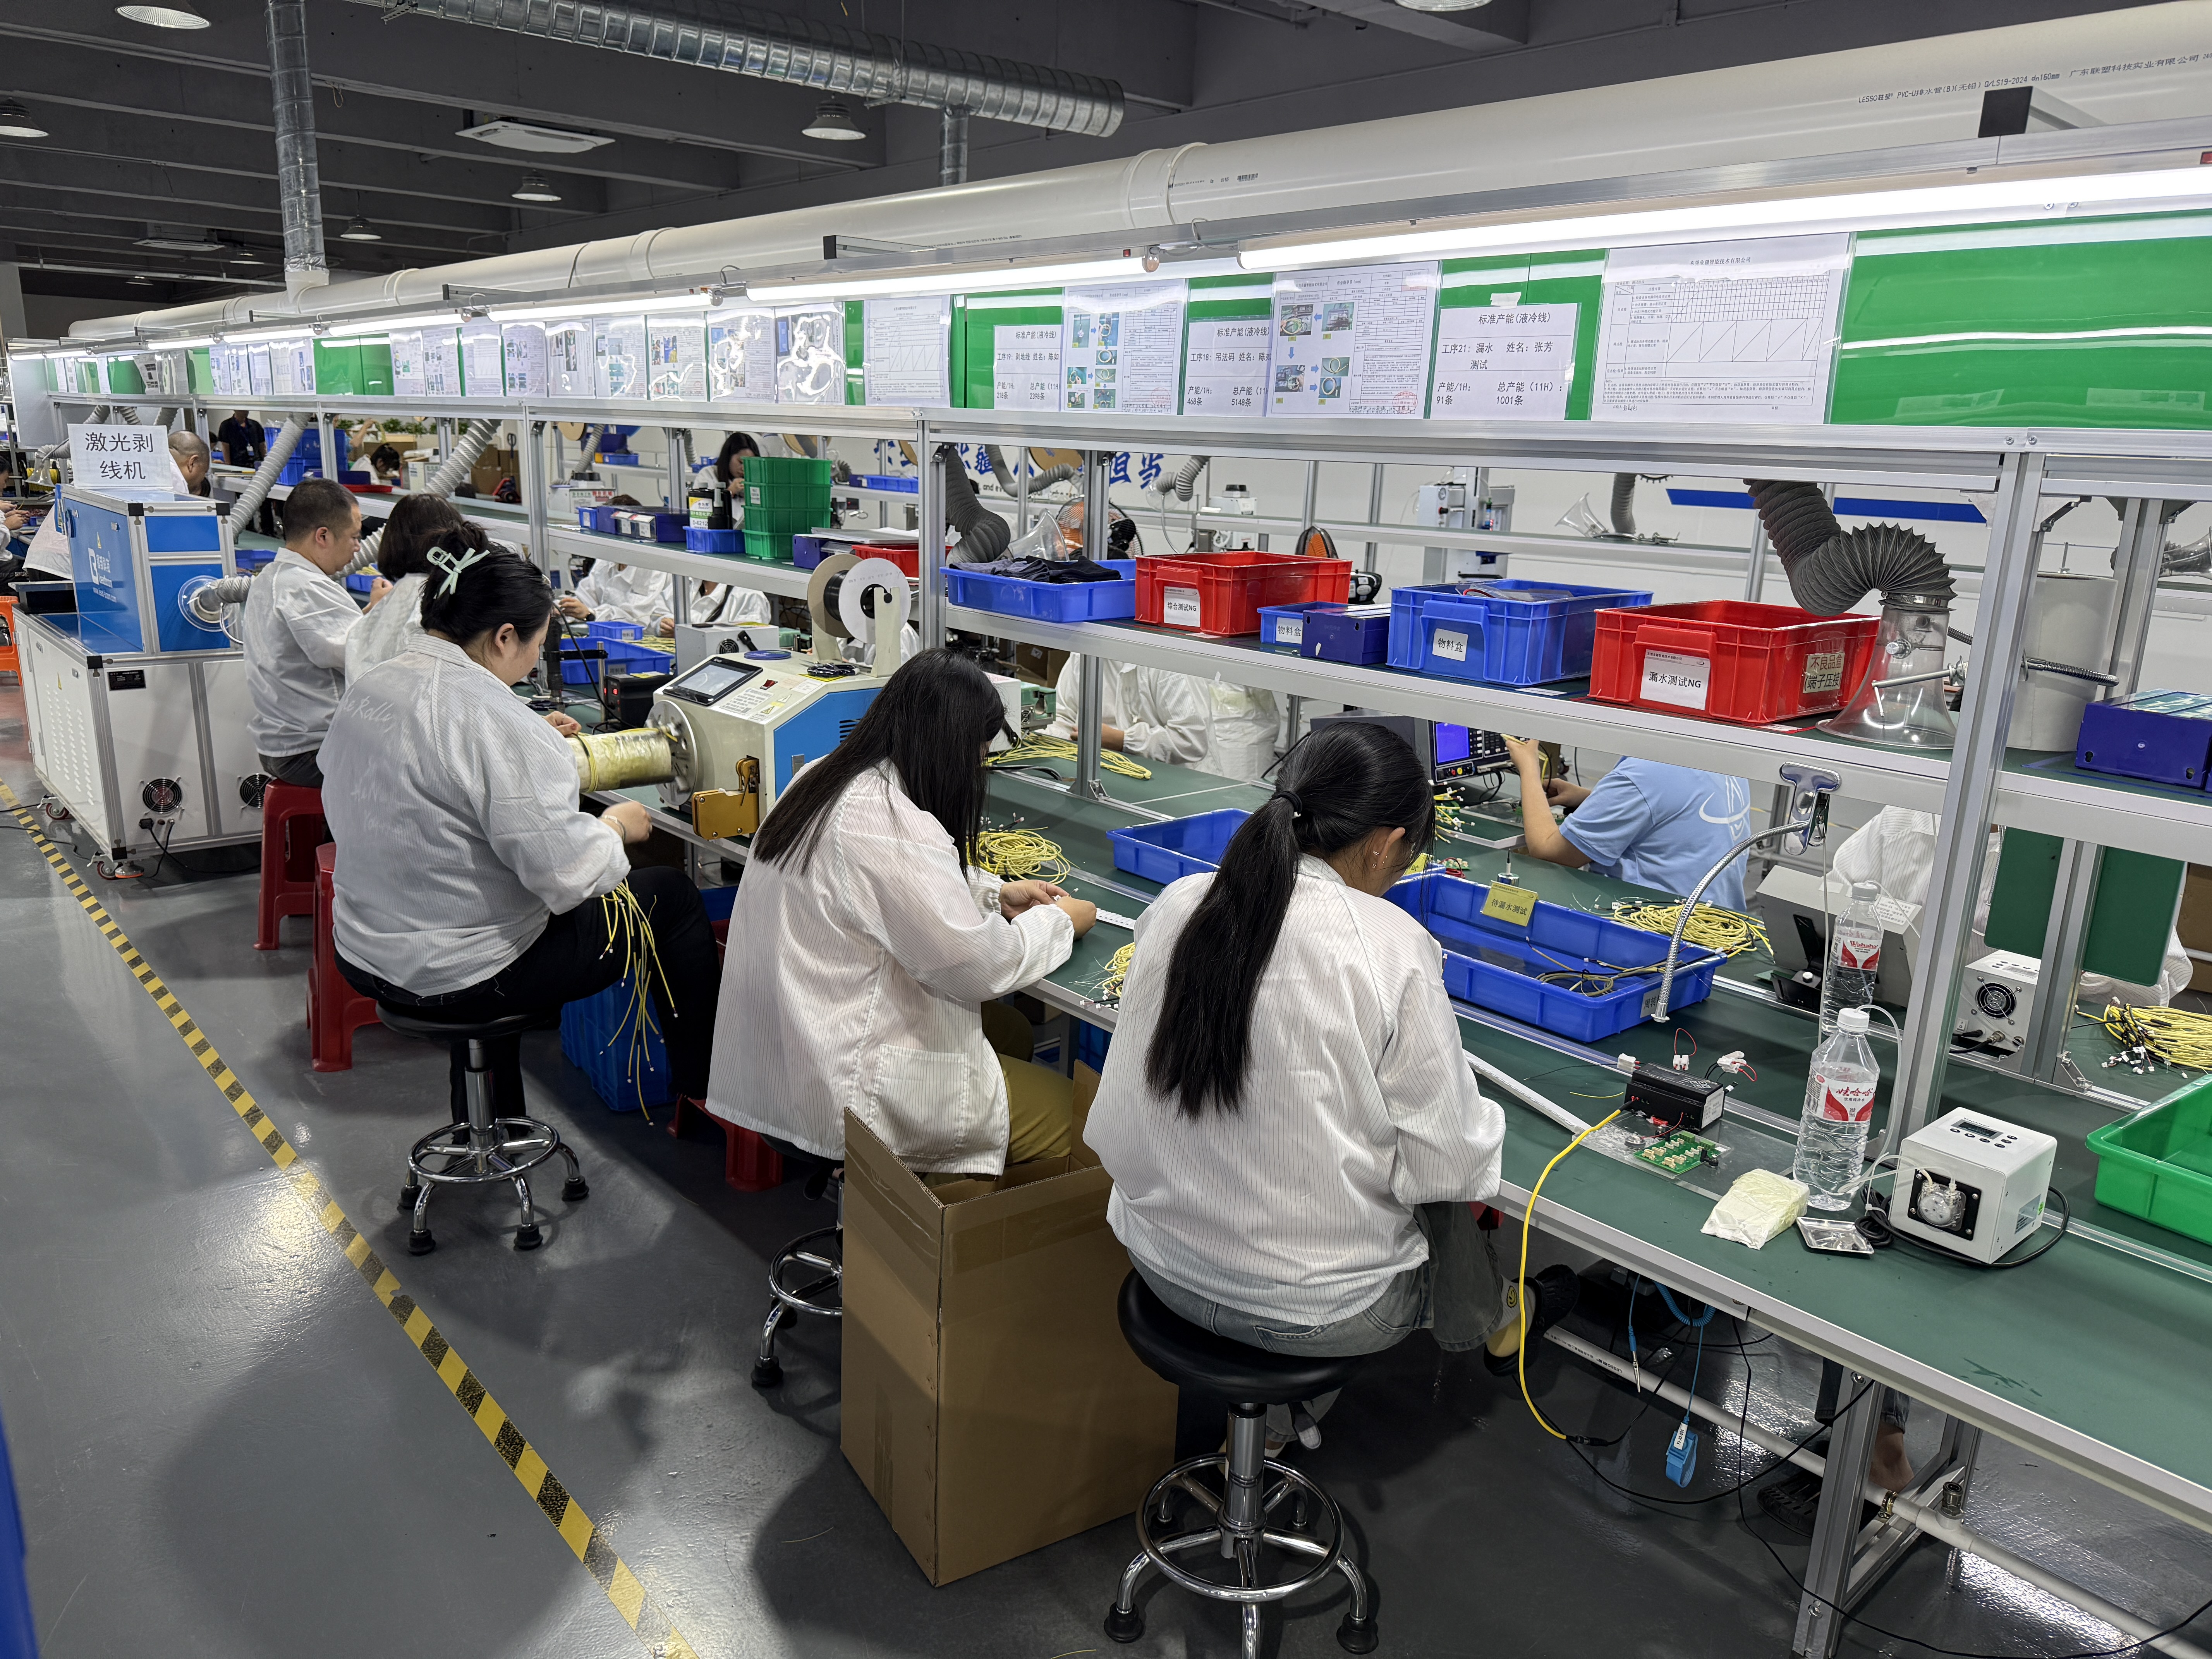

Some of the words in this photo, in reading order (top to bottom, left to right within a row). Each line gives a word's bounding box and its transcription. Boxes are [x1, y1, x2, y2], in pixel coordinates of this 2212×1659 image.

[1478, 312, 1551, 325] 标准产能(液冷线)
[1217, 327, 1270, 337] 标准产能(液冷线)
[1470, 360, 1488, 370] 测试
[1187, 397, 1202, 406] 468条
[1231, 398, 1252, 407] 5148条
[1436, 395, 1453, 405] 91条
[1496, 395, 1523, 405] 1001条
[85, 432, 153, 452] 激光剥
[100, 460, 146, 479] 线机
[1167, 602, 1196, 611] 综合测试NG
[1277, 625, 1301, 636] 物料盒
[1437, 638, 1463, 653] 物料盒
[1649, 671, 1701, 688] 漏水测试NG
[1491, 898, 1528, 915] 待漏水测试
[1850, 940, 1877, 949] Wahaha
[1836, 1086, 1872, 1096] 娃哈哈
